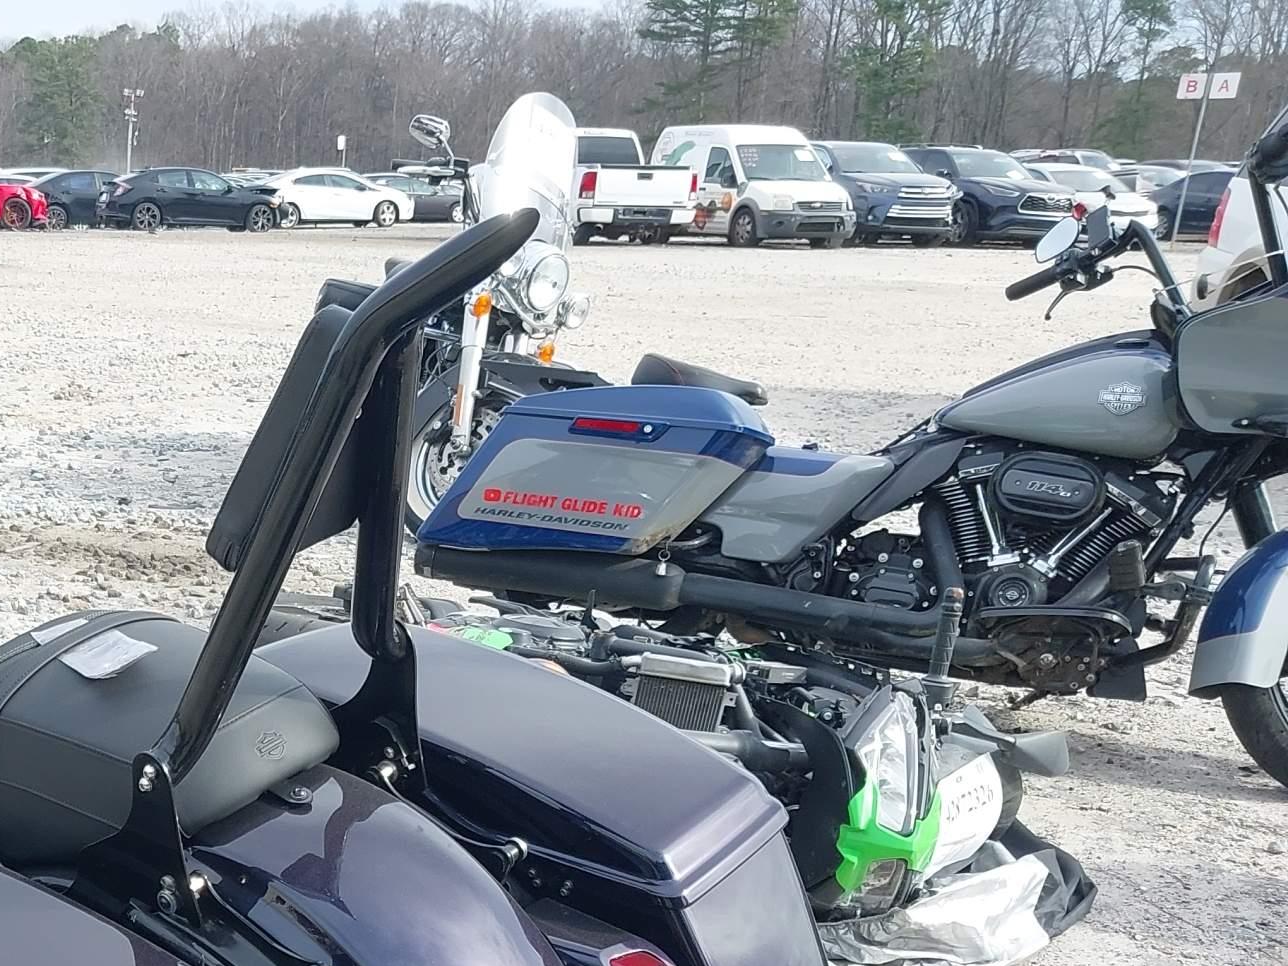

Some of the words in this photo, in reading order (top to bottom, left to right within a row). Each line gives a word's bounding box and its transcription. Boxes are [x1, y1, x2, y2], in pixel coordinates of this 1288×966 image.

[1185, 80, 1198, 93] B
[1218, 79, 1229, 93] A
[1026, 480, 1065, 495] 114
[502, 491, 558, 508] FLIGHT
[561, 498, 609, 515] GLIDE
[612, 503, 642, 519] KID
[474, 507, 630, 531] HARLEY-DAVIDSON
